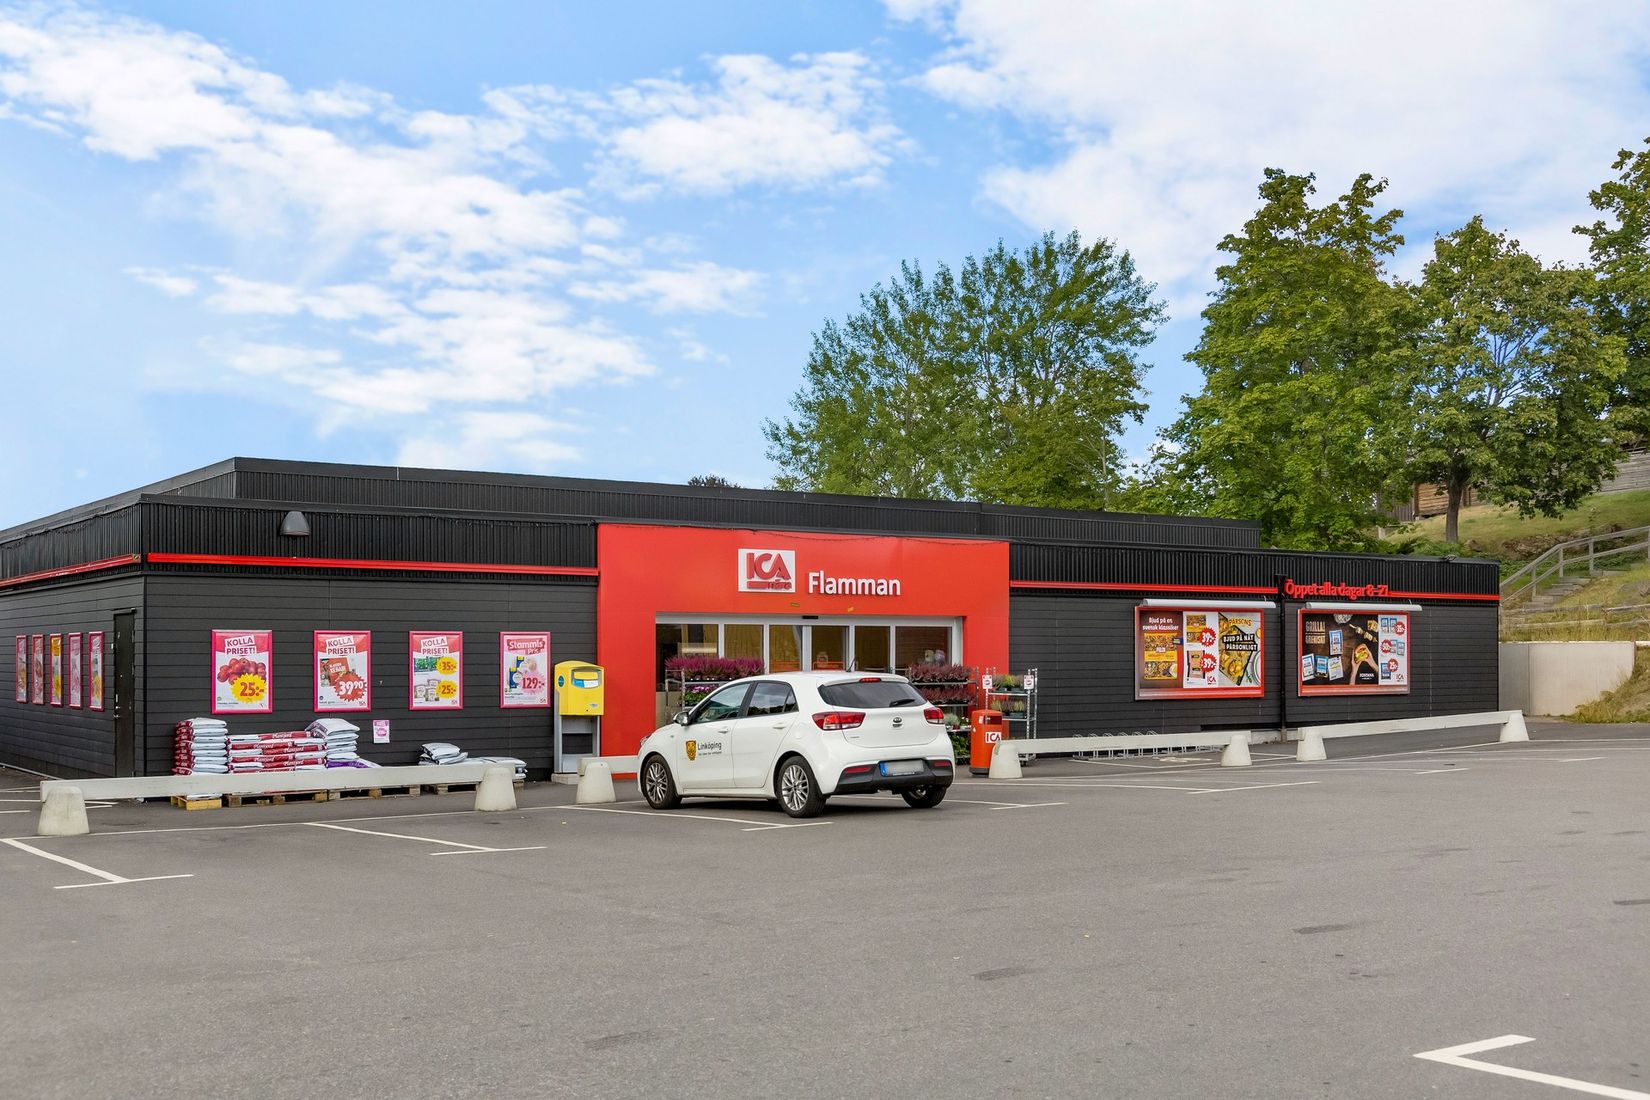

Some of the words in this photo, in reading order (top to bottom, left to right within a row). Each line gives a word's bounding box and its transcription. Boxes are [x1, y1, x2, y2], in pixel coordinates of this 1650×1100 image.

[746, 552, 791, 579] ICA
[808, 570, 901, 596] Flamman
[1284, 579, 1319, 598] Öppet
[1319, 582, 1337, 596] alla
[1338, 582, 1366, 600] dagar
[226, 637, 254, 647] KOLLA
[327, 637, 353, 647] KOLLA
[422, 638, 446, 647] KOLLA
[226, 647, 256, 655] PRISET!
[327, 647, 355, 655] PRISET!
[522, 677, 545, 689] 129:-
[240, 681, 265, 697] 25:-
[986, 733, 1001, 742] ICA
